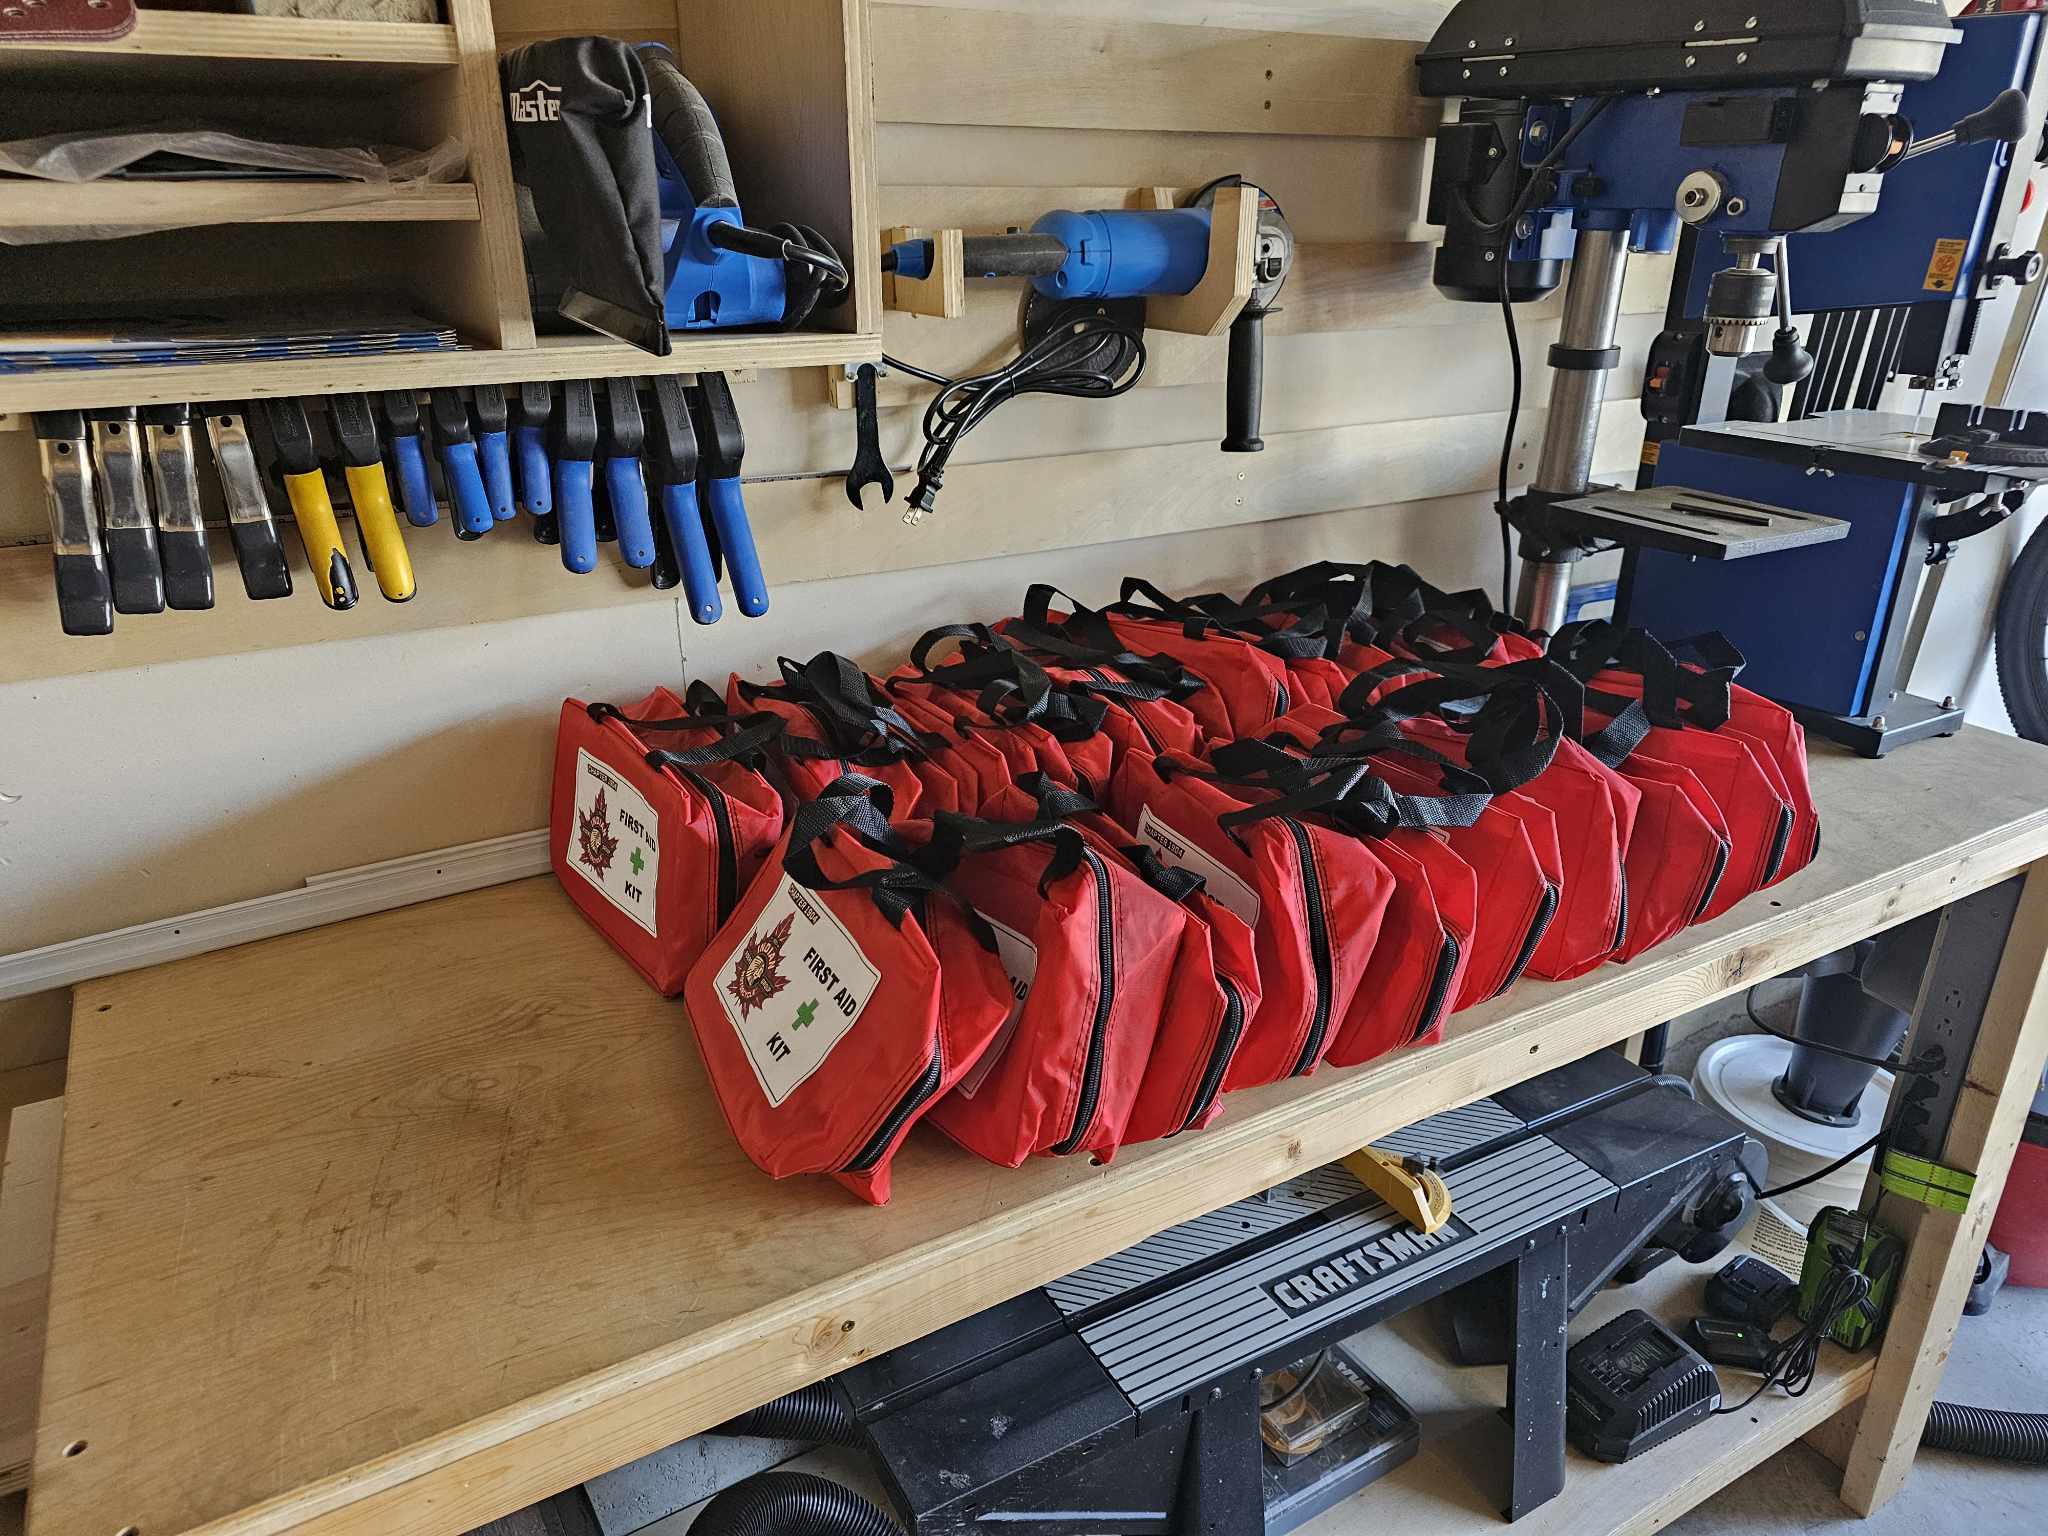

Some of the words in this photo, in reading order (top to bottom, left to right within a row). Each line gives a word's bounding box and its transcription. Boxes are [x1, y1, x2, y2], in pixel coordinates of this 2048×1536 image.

[619, 808, 645, 838] FIRST
[645, 831, 656, 852] AID
[624, 880, 642, 903] KIT
[757, 942, 776, 970] INDIAN
[803, 946, 840, 992] FIRST
[833, 987, 857, 1017] AID
[766, 1031, 792, 1062] KIT
[1273, 1222, 1461, 1310] CRAFTSMAN
